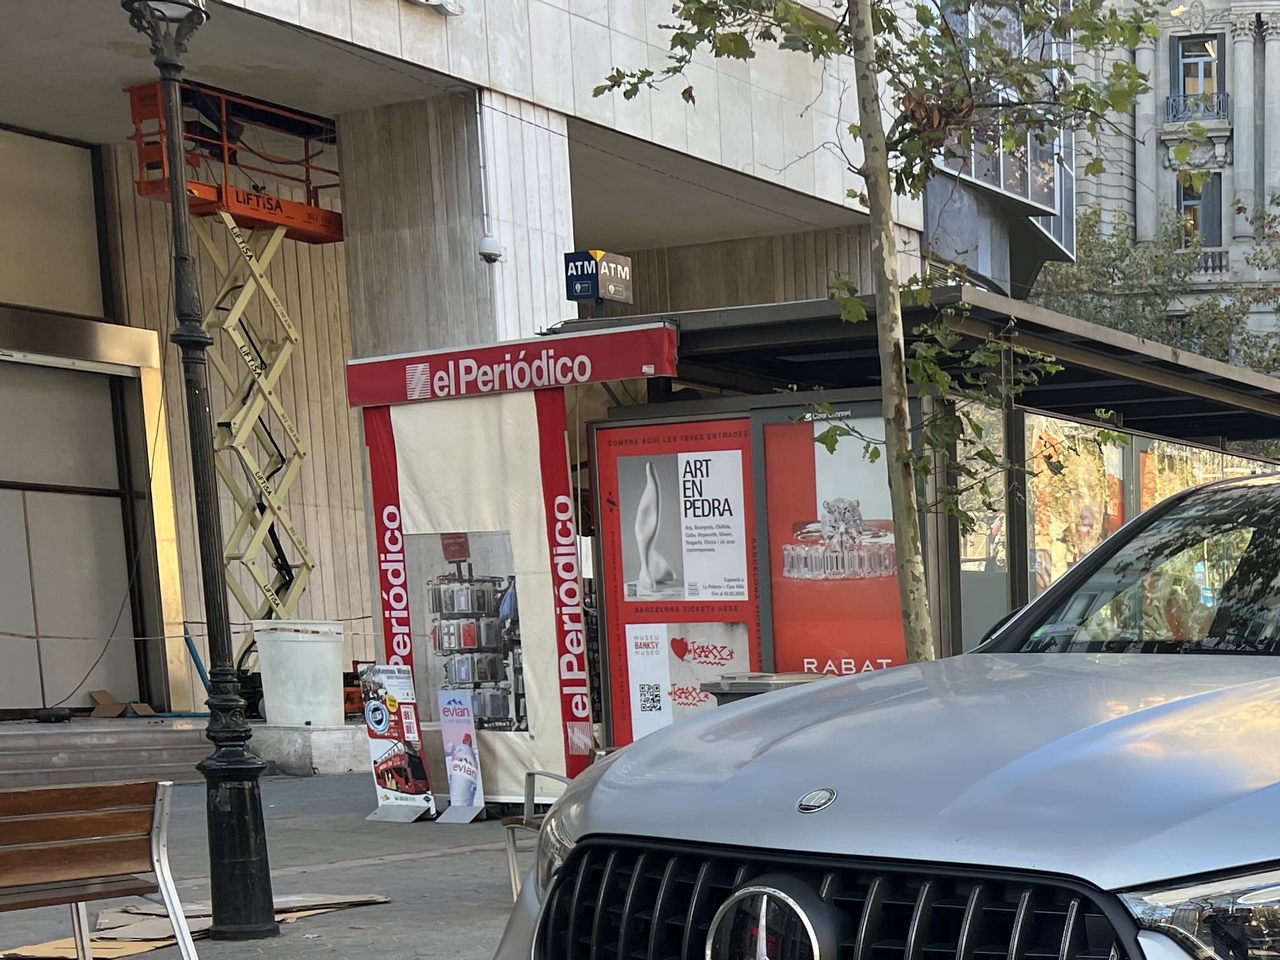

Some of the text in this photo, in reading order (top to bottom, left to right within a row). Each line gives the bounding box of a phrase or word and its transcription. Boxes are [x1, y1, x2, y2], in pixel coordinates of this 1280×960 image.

[567, 260, 596, 276] ATM
[600, 261, 630, 280] ATM
[459, 349, 592, 394] Periódico
[607, 439, 639, 447] COMPRA
[662, 435, 677, 443] LES
[680, 433, 704, 442] TEVES
[707, 430, 749, 441] ENTRADES
[682, 459, 712, 479] ART
[683, 479, 703, 498] EN
[684, 498, 733, 518] PEDRA
[553, 495, 588, 680] Periódico
[634, 606, 680, 614] BARCELONA
[634, 641, 659, 650] BANKSY
[803, 658, 892, 674] RABAT
[442, 707, 470, 717] evian
[453, 763, 477, 780] evian
